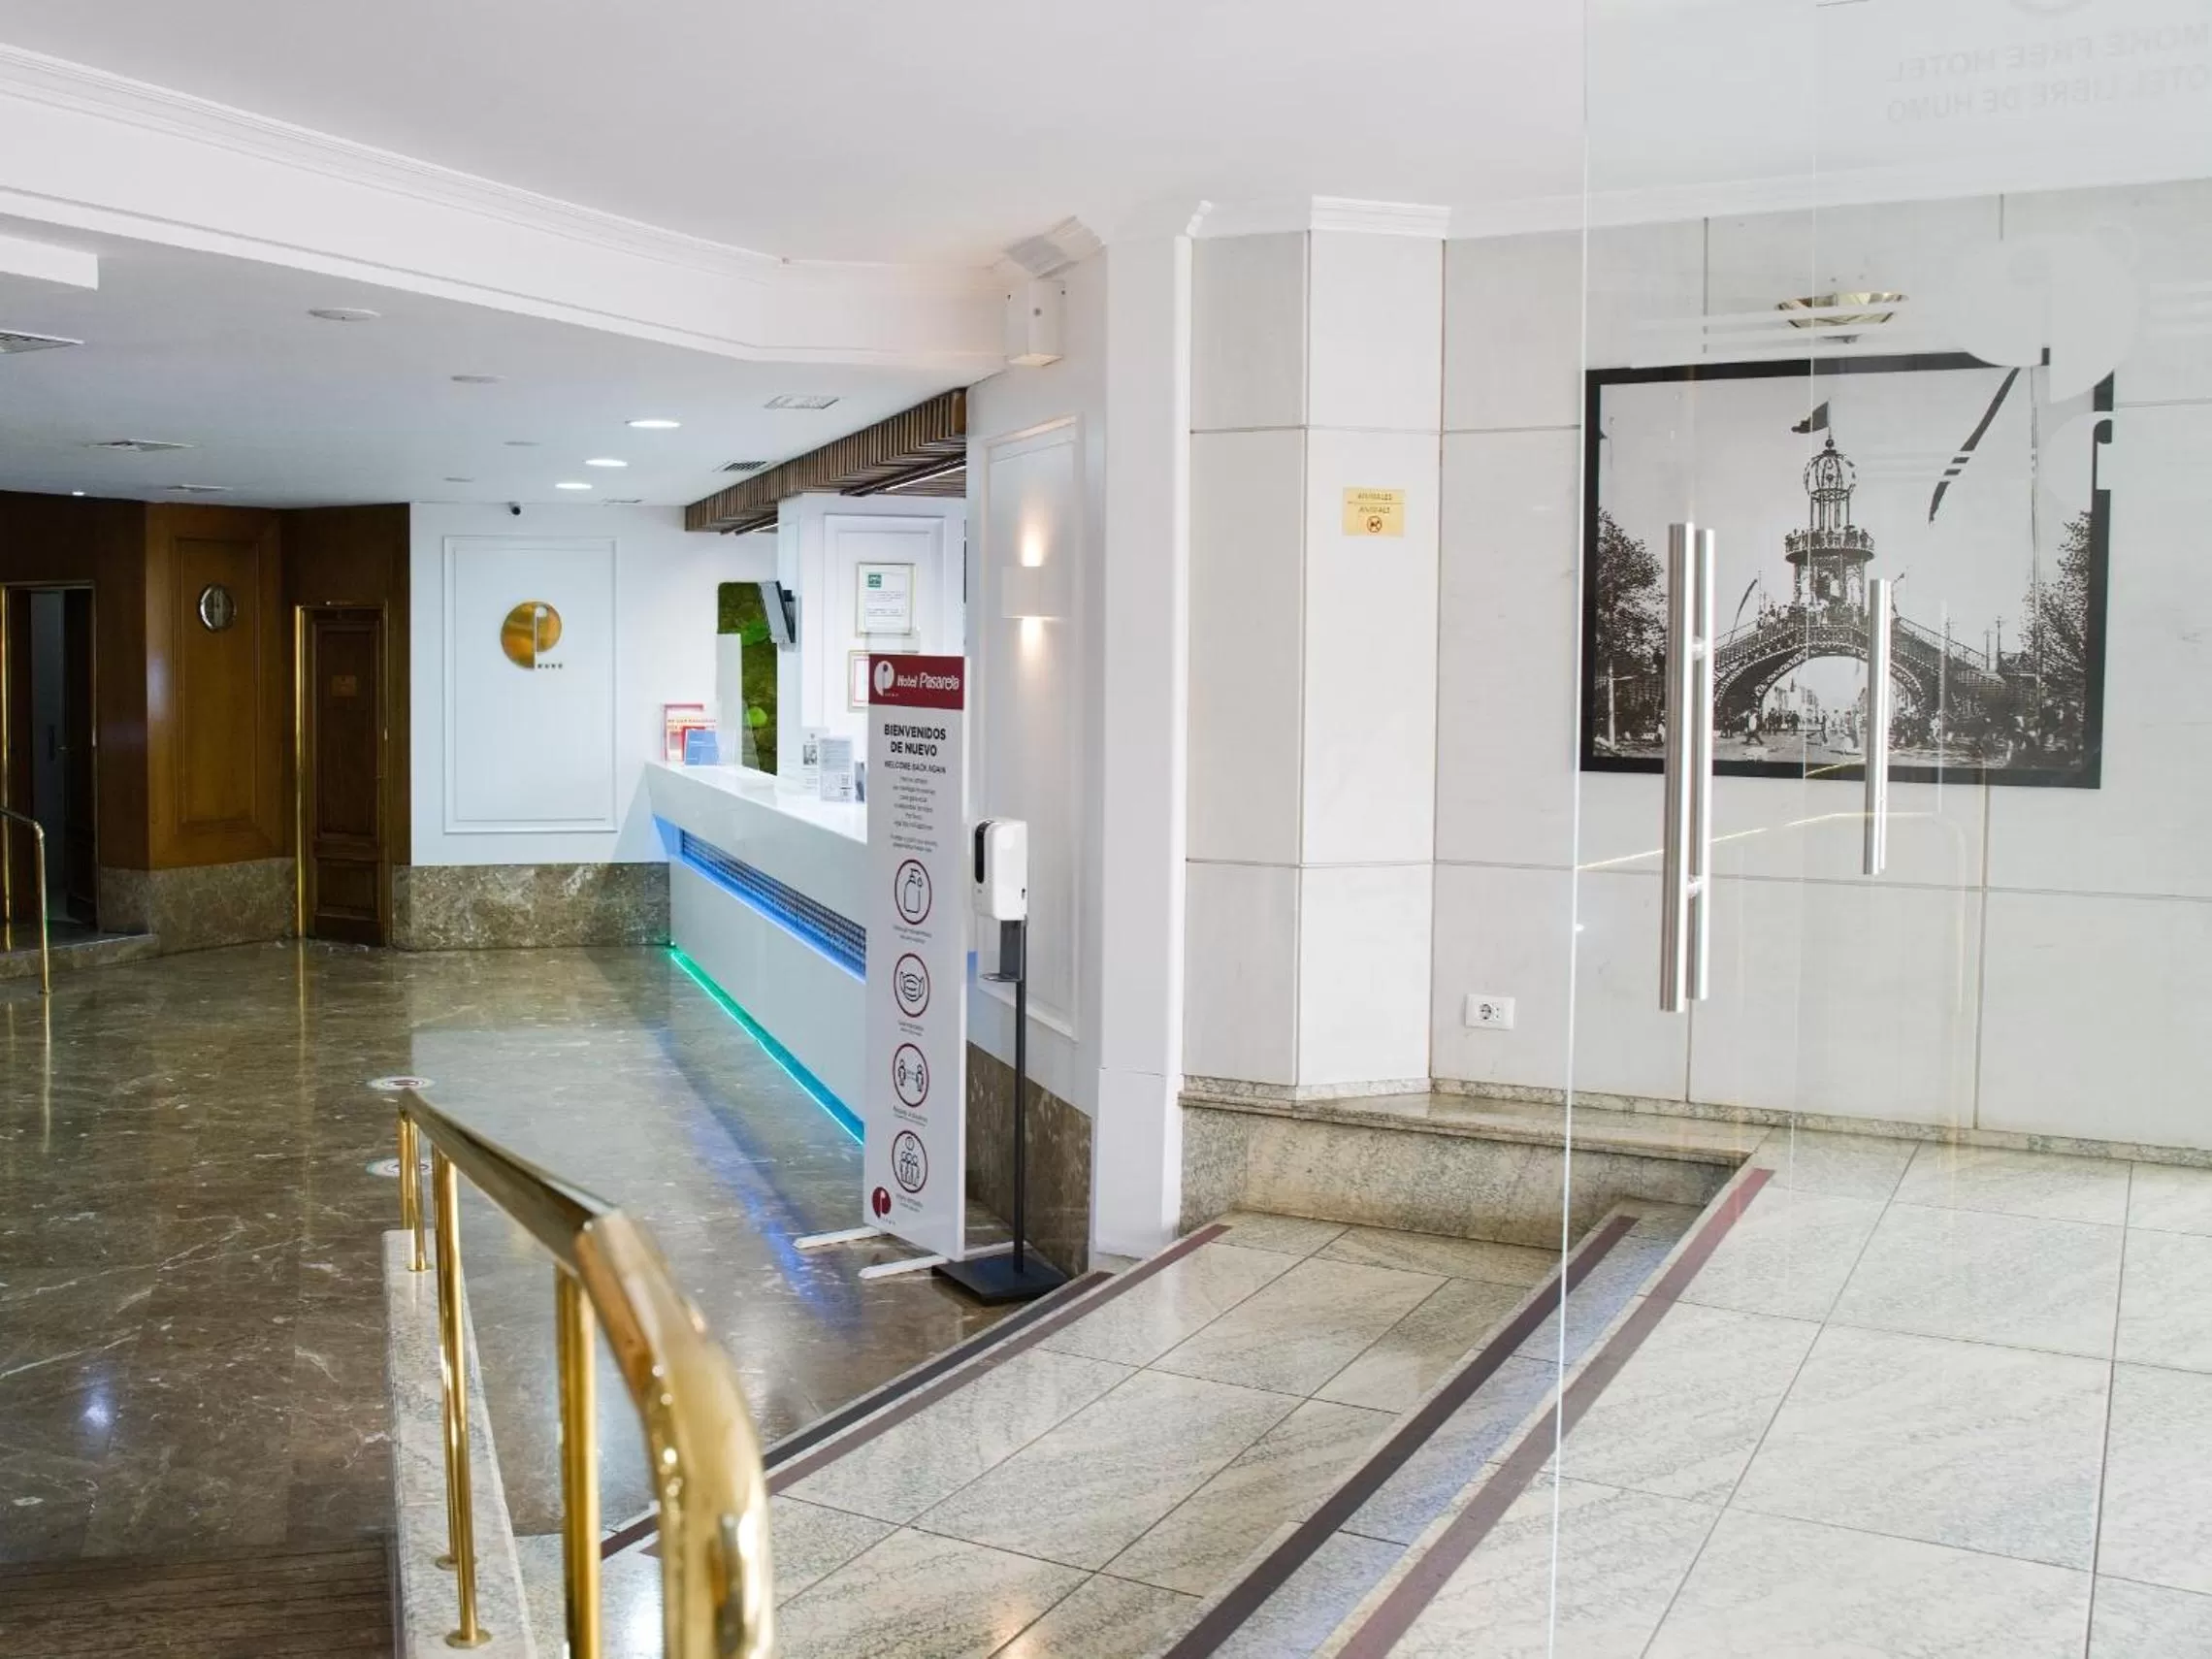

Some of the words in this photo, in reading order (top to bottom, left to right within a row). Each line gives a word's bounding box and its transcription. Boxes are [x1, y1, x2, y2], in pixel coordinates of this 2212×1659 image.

[920, 672, 960, 691] Pasarela
[884, 724, 946, 740] BIENVENIDOS
[891, 741, 903, 753] DE
[904, 742, 937, 757] NUEVO
